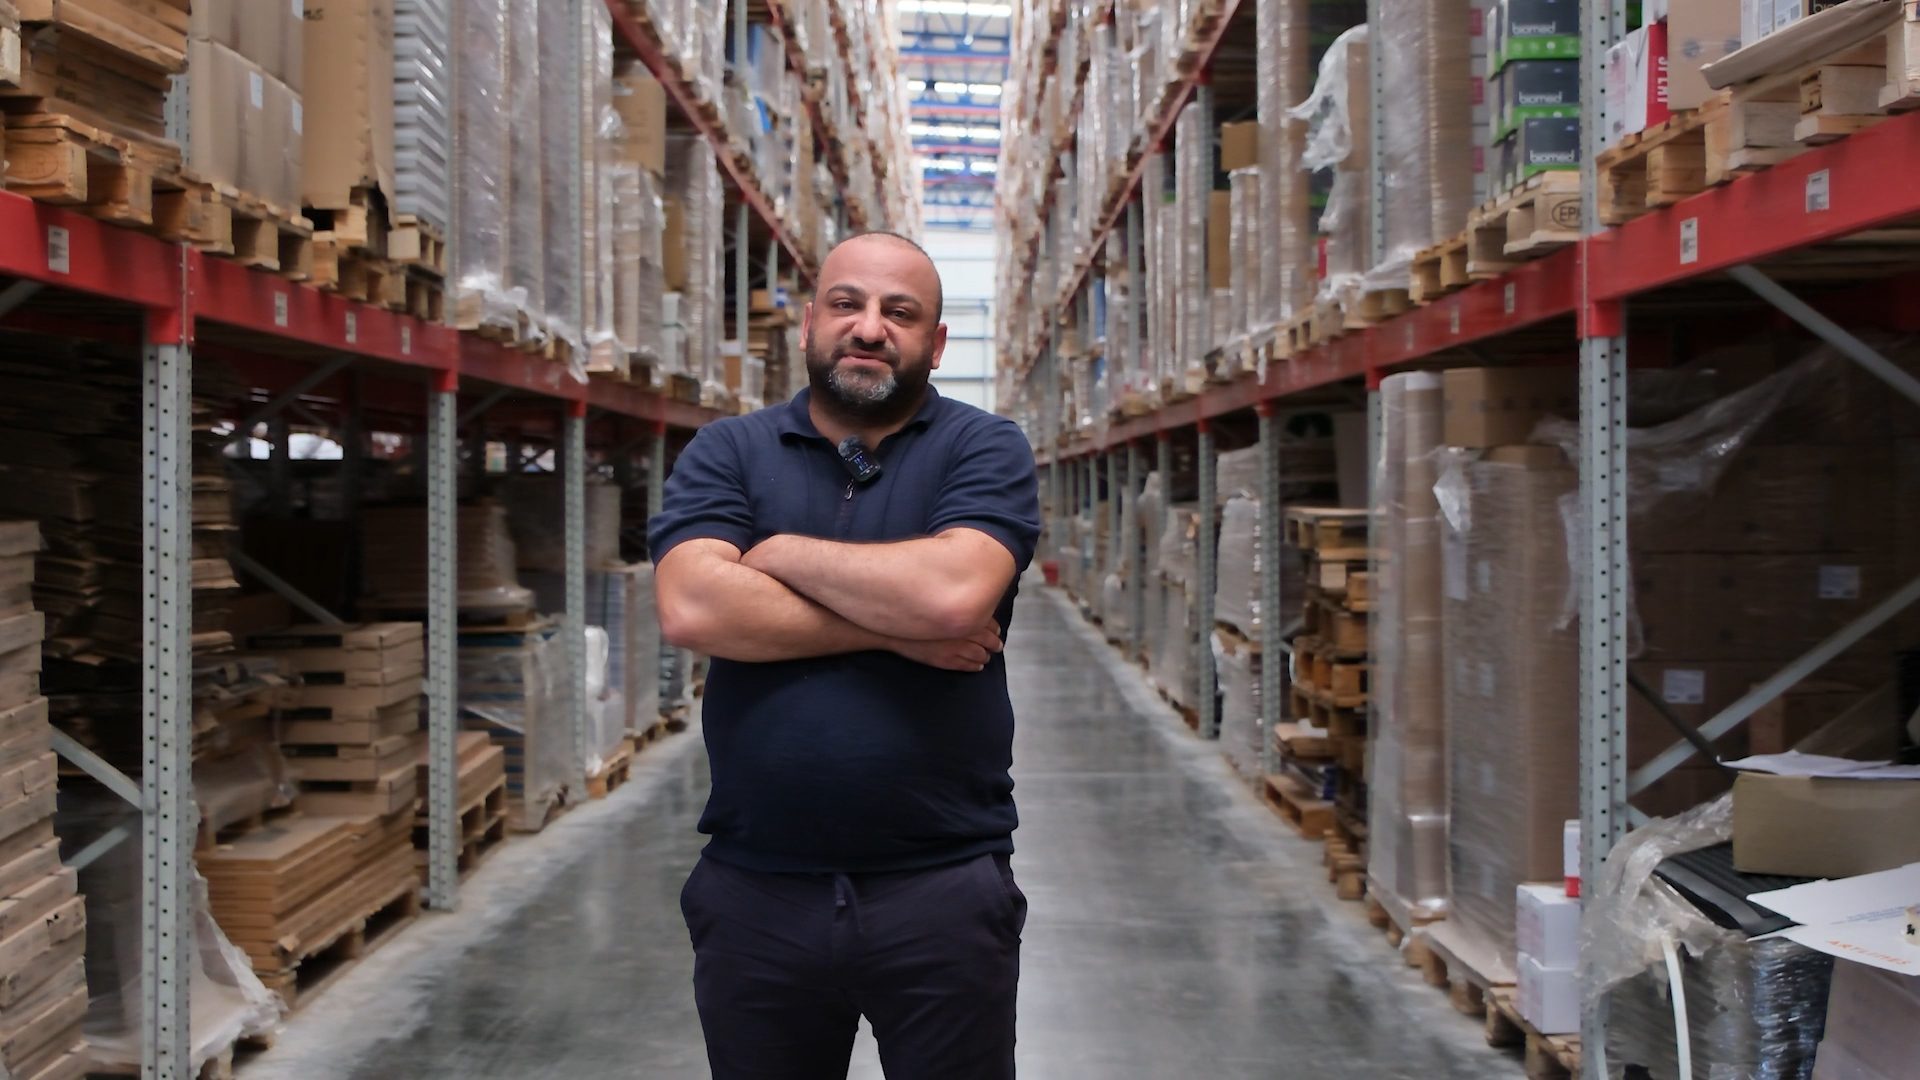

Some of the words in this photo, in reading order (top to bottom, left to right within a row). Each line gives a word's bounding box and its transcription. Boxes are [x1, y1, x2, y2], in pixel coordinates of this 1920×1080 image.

[1512, 21, 1556, 35] biomed
[1519, 91, 1562, 105] biomed
[1529, 149, 1575, 164] biomed
